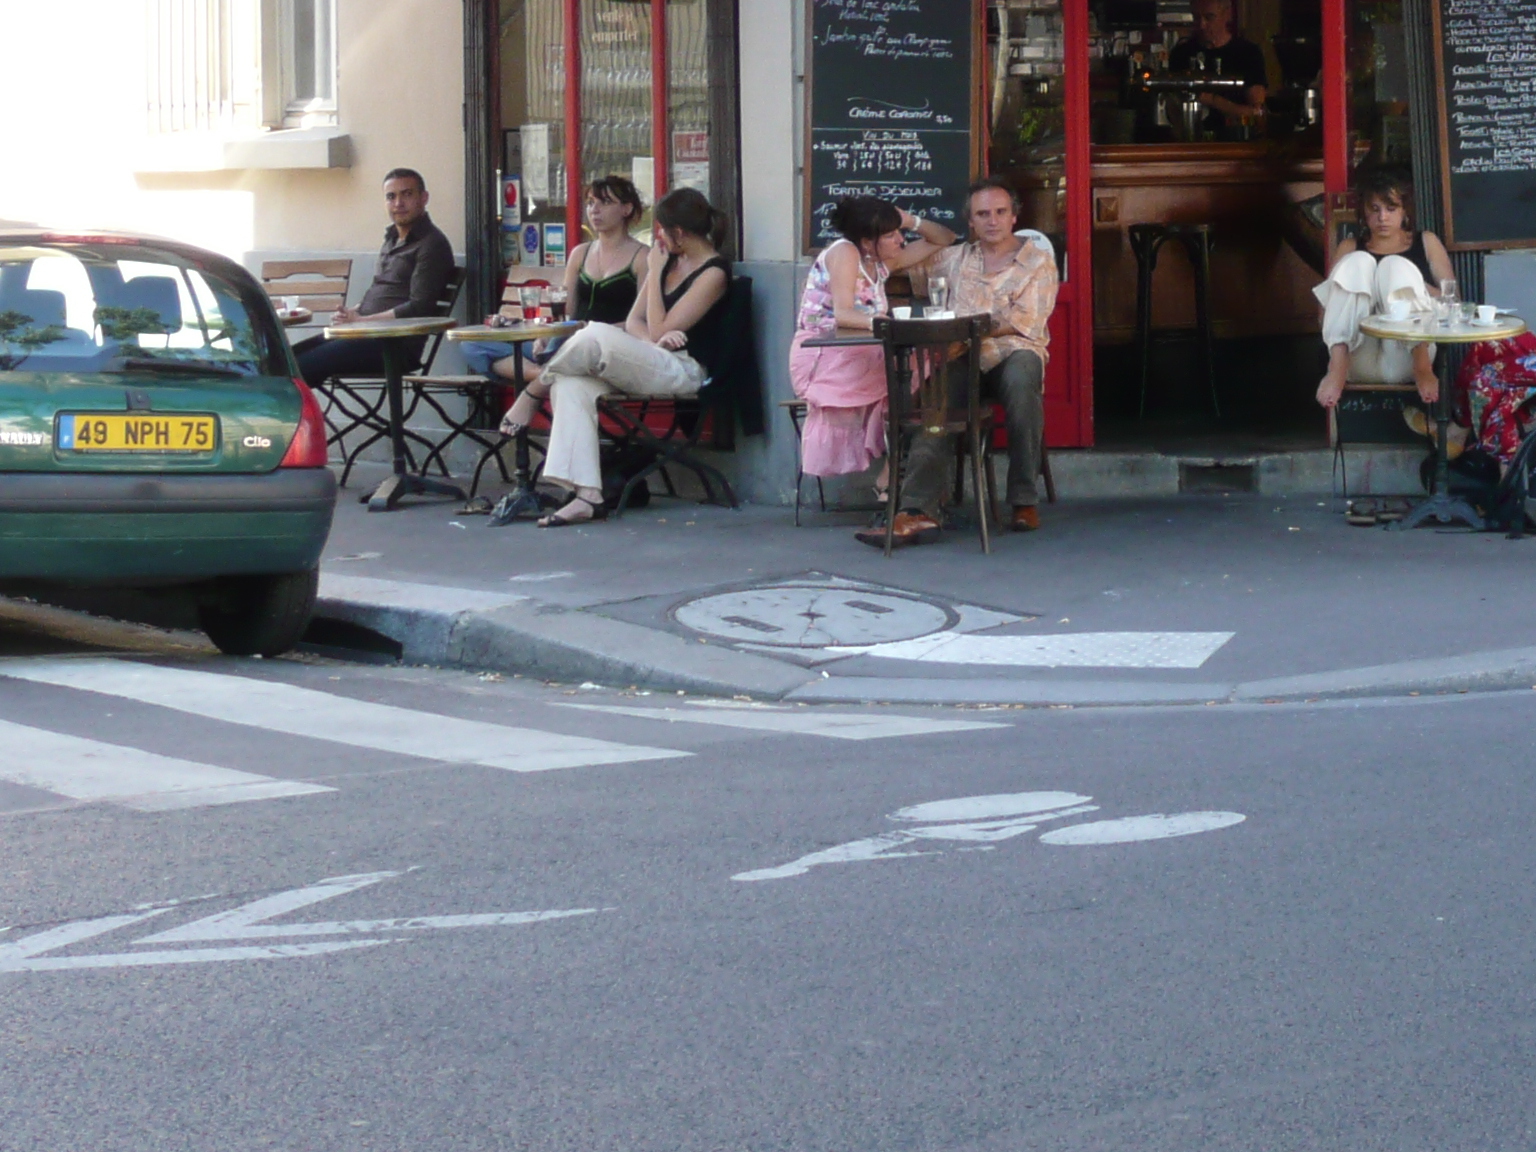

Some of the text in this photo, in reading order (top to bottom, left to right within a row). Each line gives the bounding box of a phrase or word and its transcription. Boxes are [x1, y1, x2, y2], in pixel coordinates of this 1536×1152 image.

[77, 420, 209, 446] 49 NPH 75
[243, 435, 272, 448] Clio
